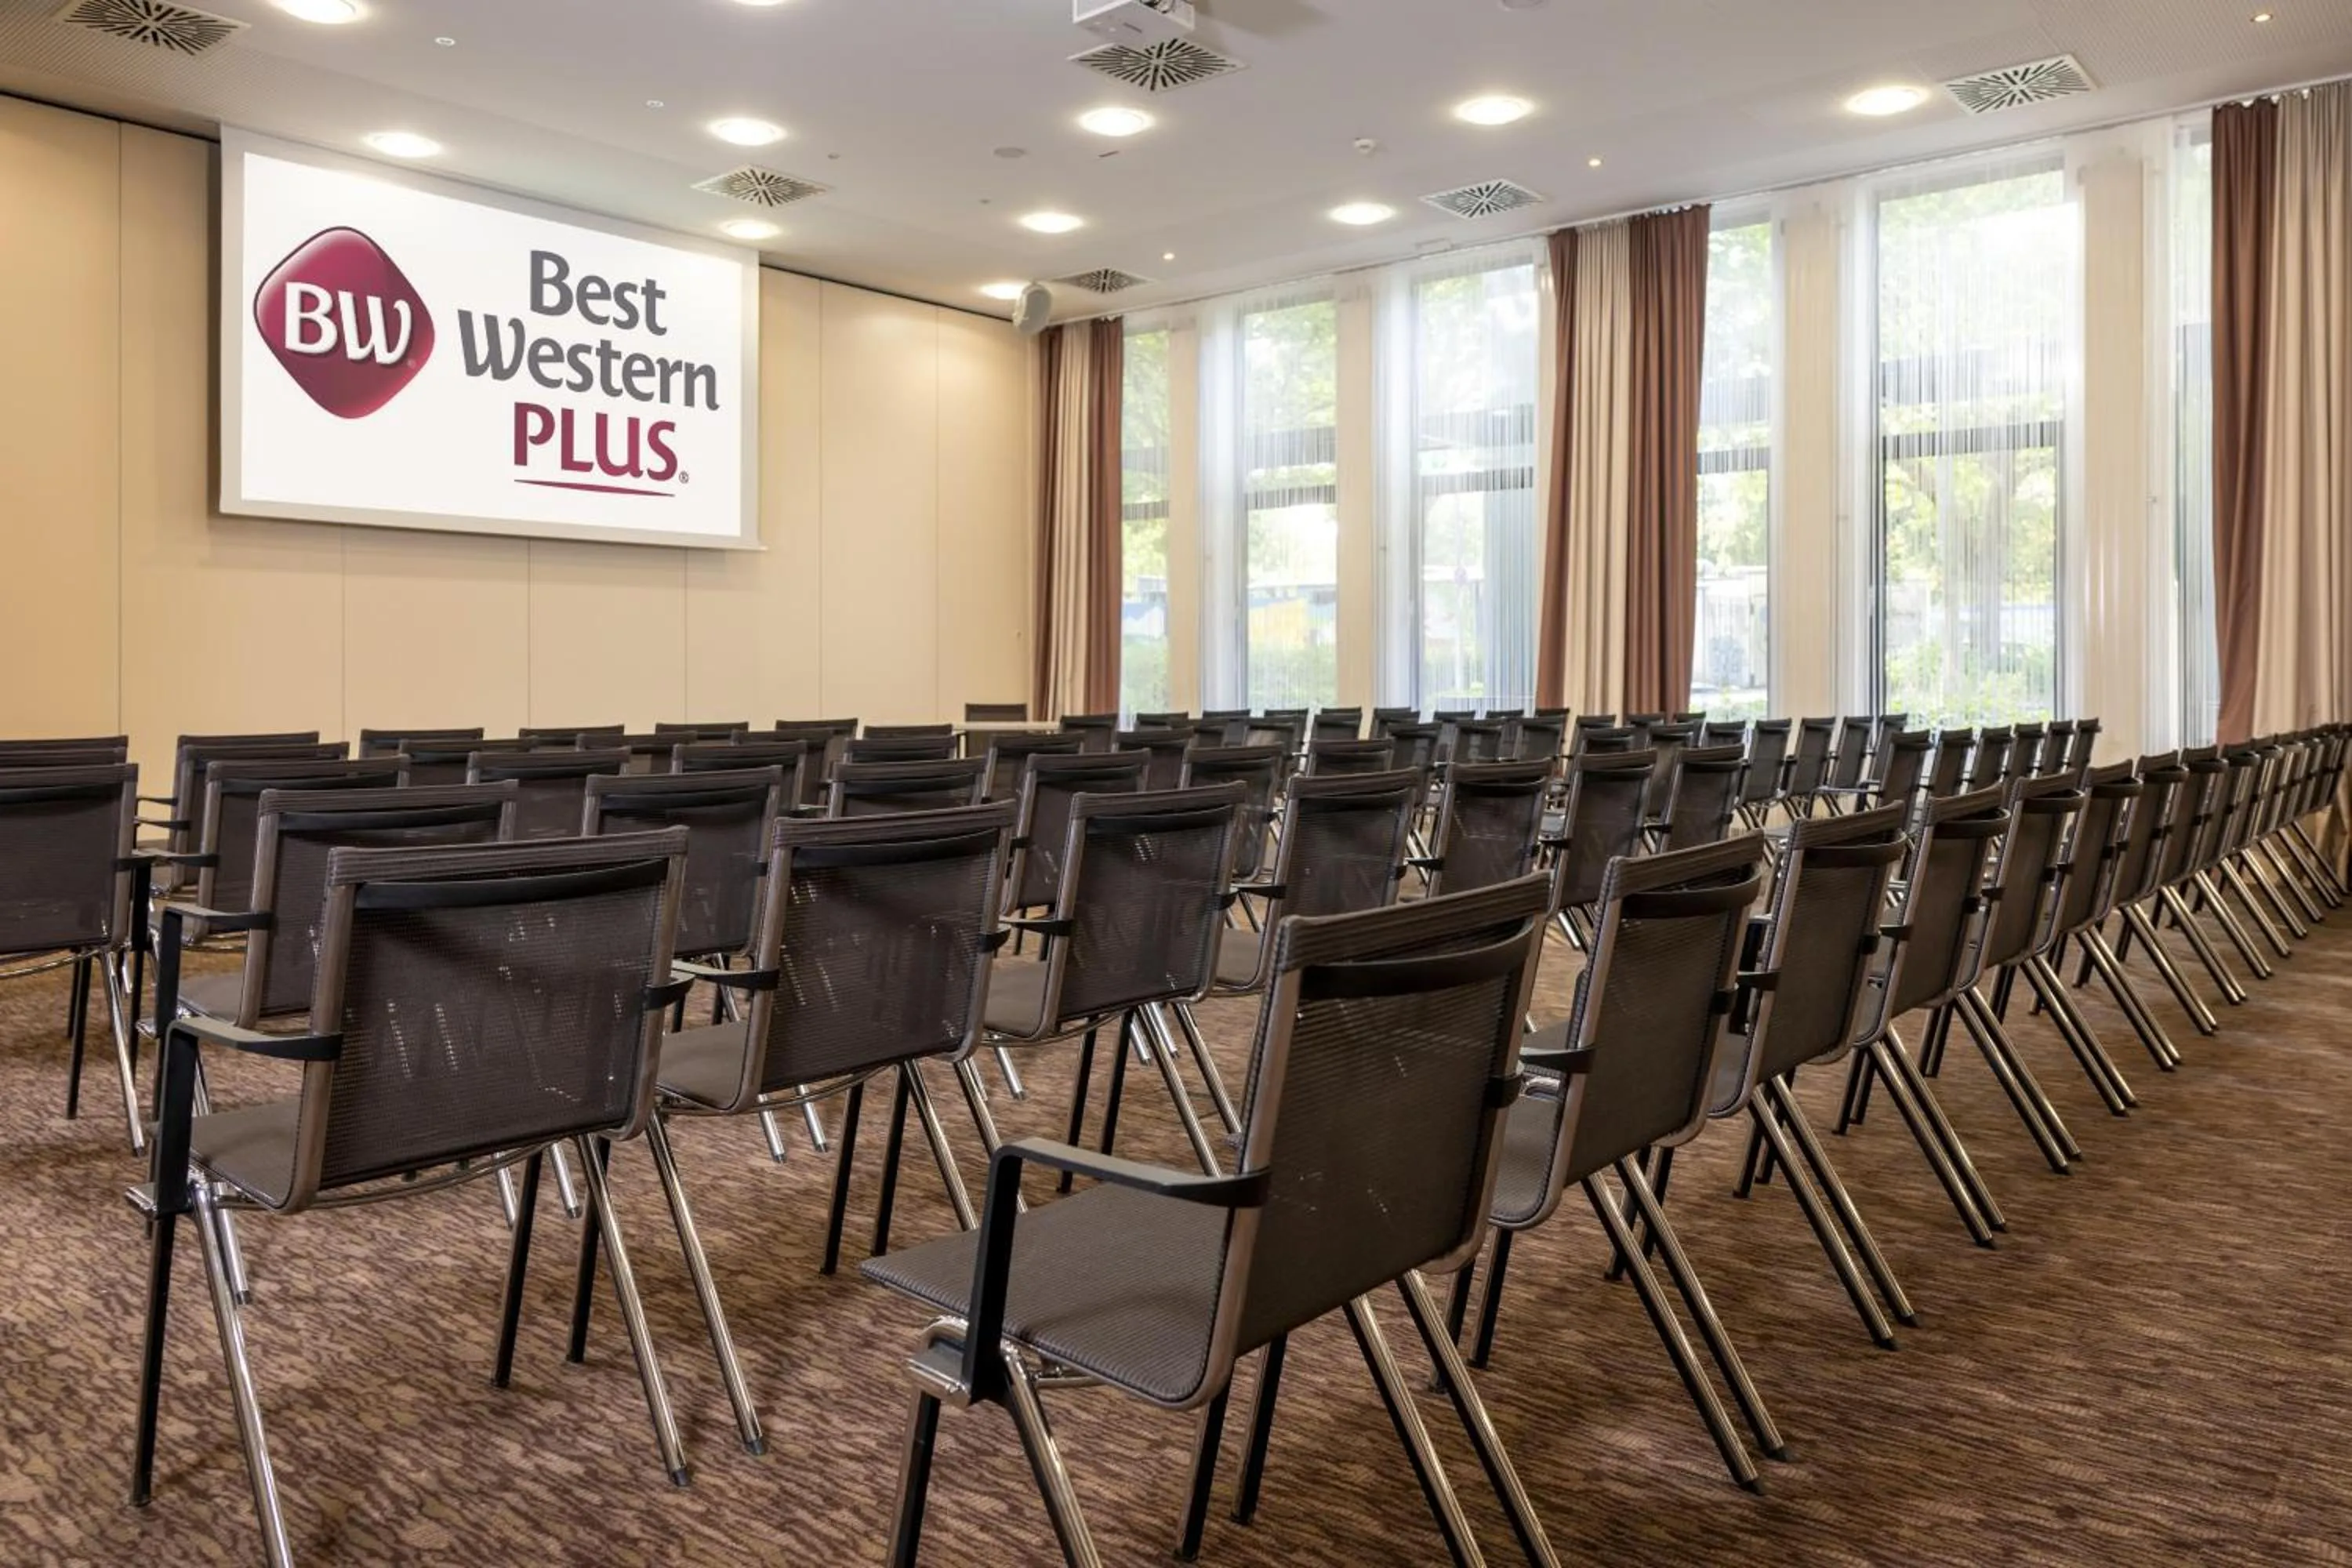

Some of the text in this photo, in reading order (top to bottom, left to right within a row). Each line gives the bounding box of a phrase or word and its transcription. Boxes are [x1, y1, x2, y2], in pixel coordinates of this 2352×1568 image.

[285, 281, 412, 366] BW
[529, 249, 667, 336] Best
[457, 309, 720, 412] Western
